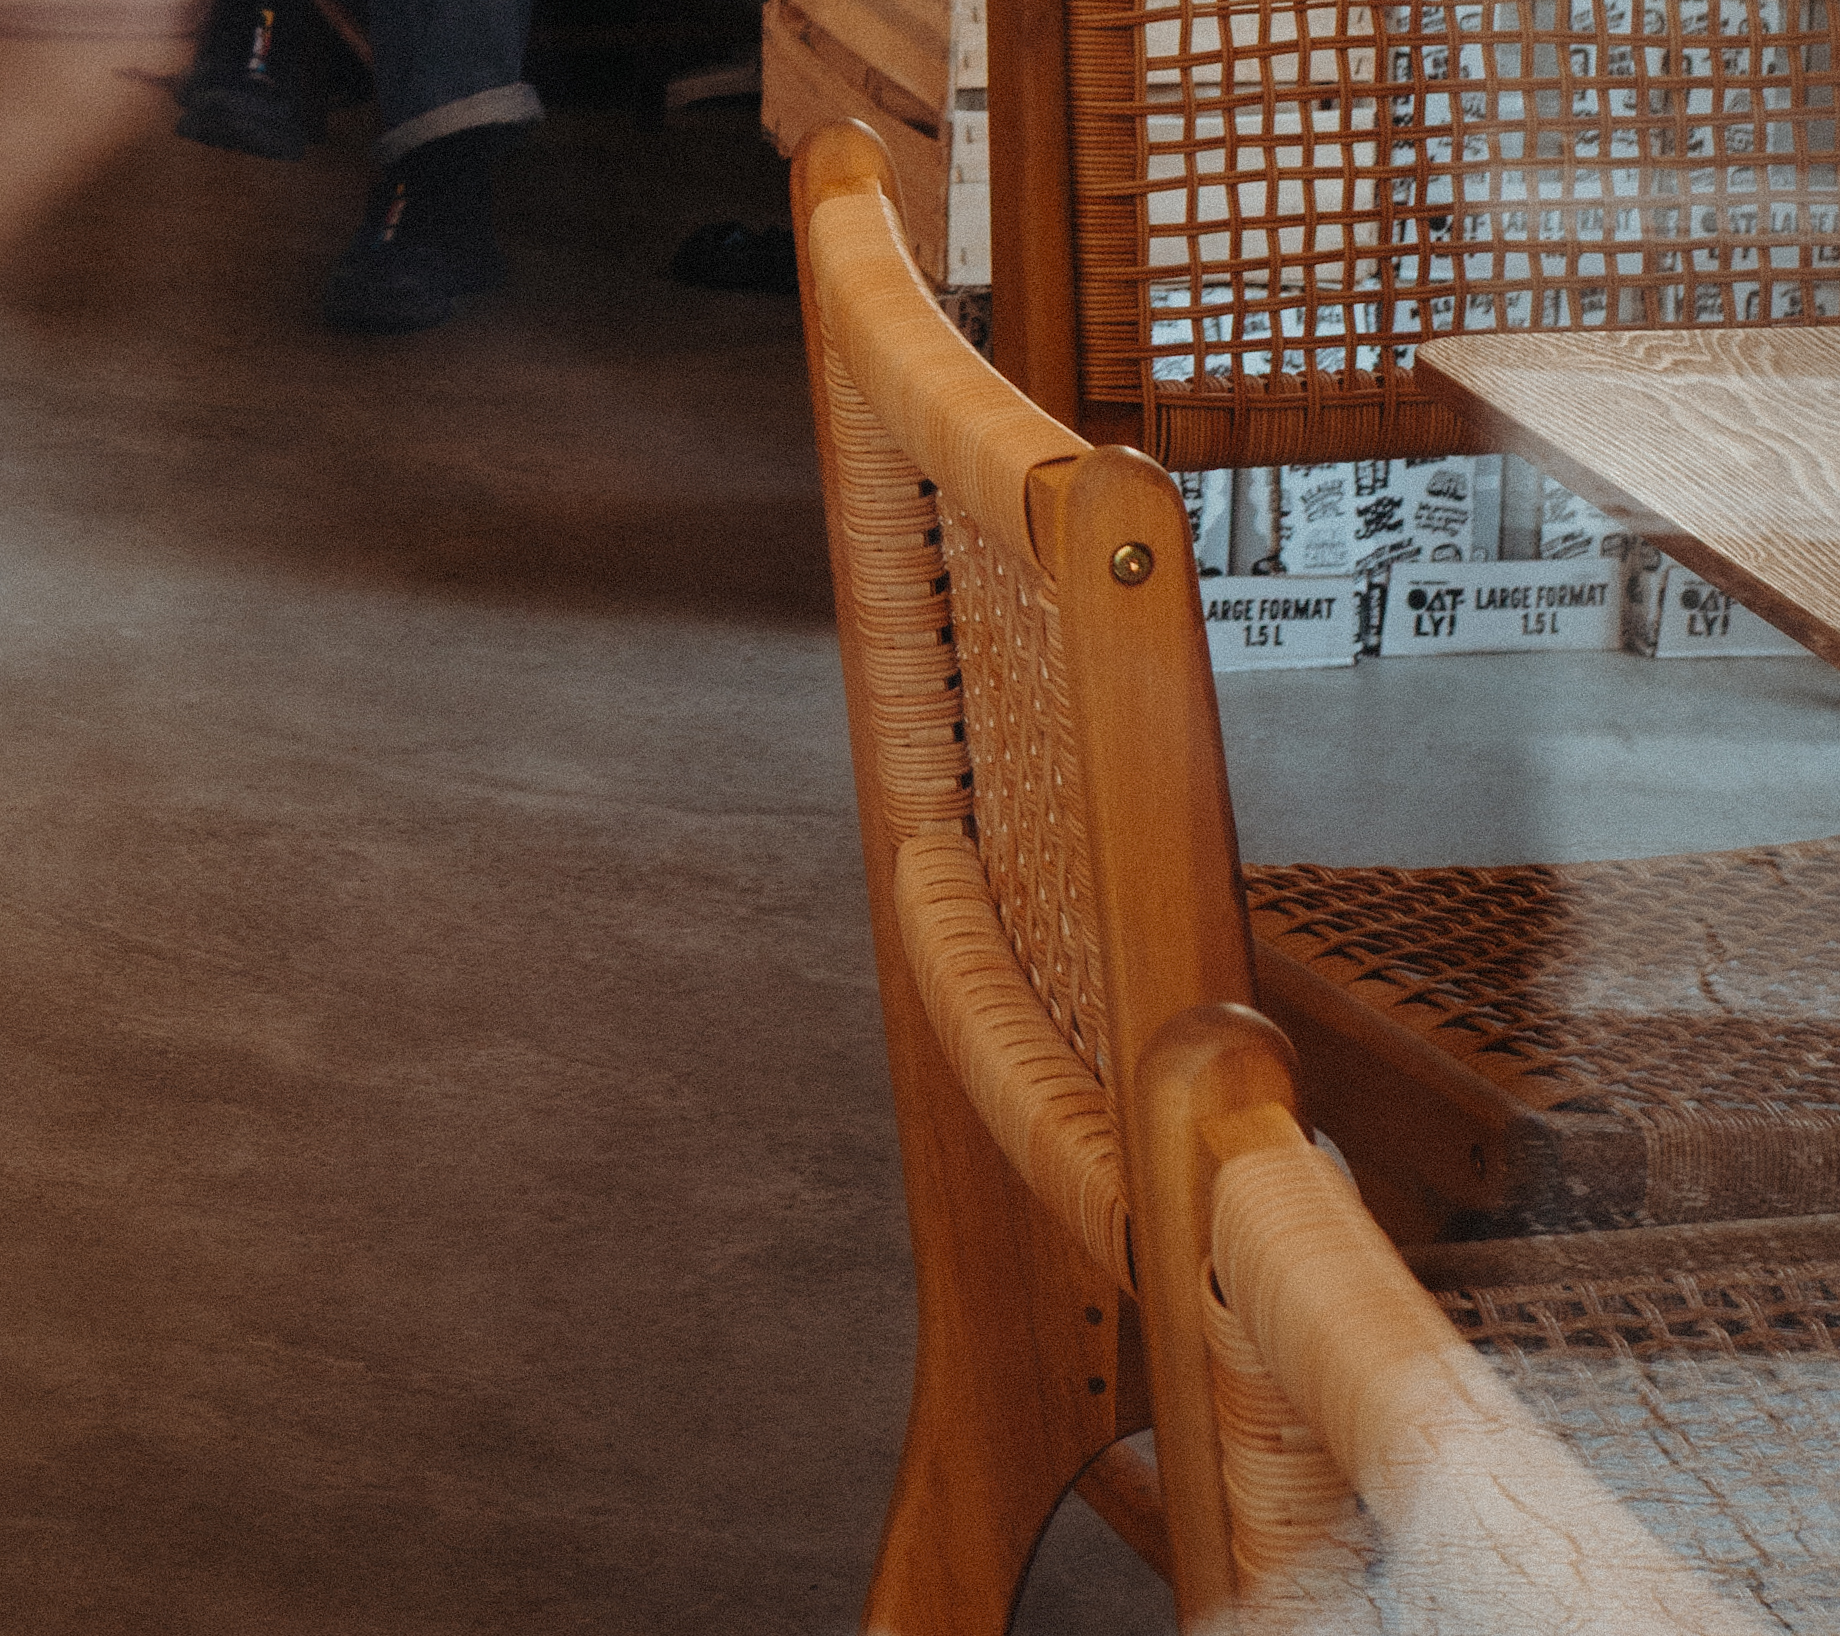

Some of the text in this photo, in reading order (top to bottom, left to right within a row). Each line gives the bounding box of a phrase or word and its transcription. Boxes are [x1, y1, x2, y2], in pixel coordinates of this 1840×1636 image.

[1206, 596, 1337, 621] ARGE FORMAT
[1475, 582, 1609, 611] LARGE FORMAT
[1273, 624, 1284, 647] L
